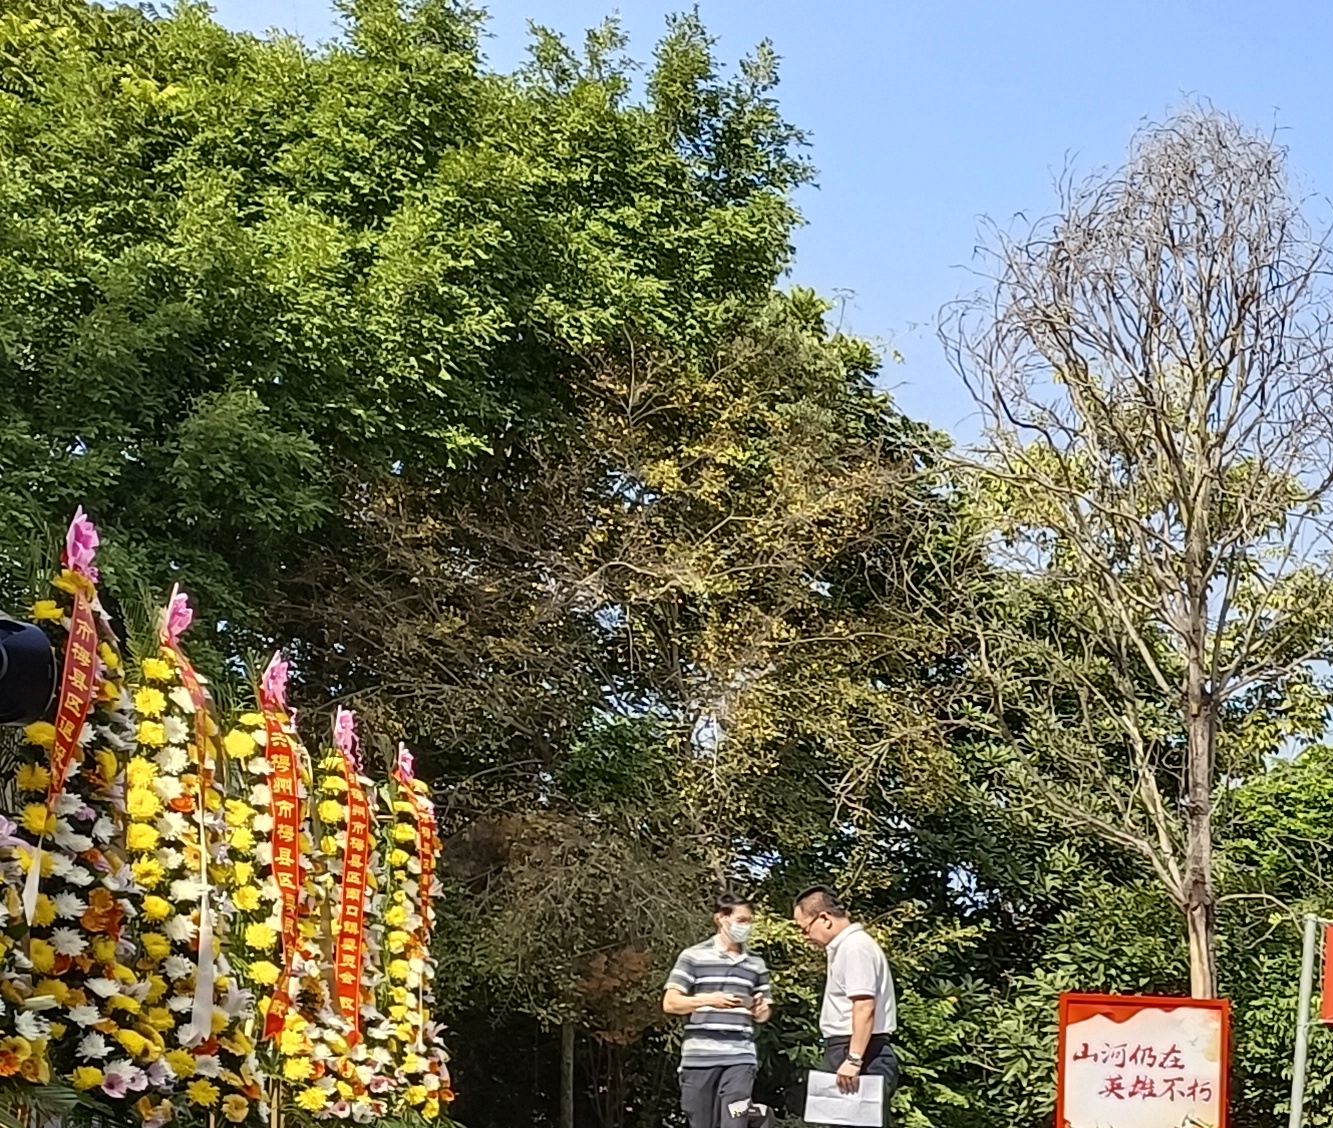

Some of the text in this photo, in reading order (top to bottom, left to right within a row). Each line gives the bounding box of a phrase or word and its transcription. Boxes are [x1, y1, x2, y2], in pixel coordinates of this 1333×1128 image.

[1073, 1043, 1185, 1070] 山河仍在
[1099, 1074, 1213, 1102] 英雄不朽
